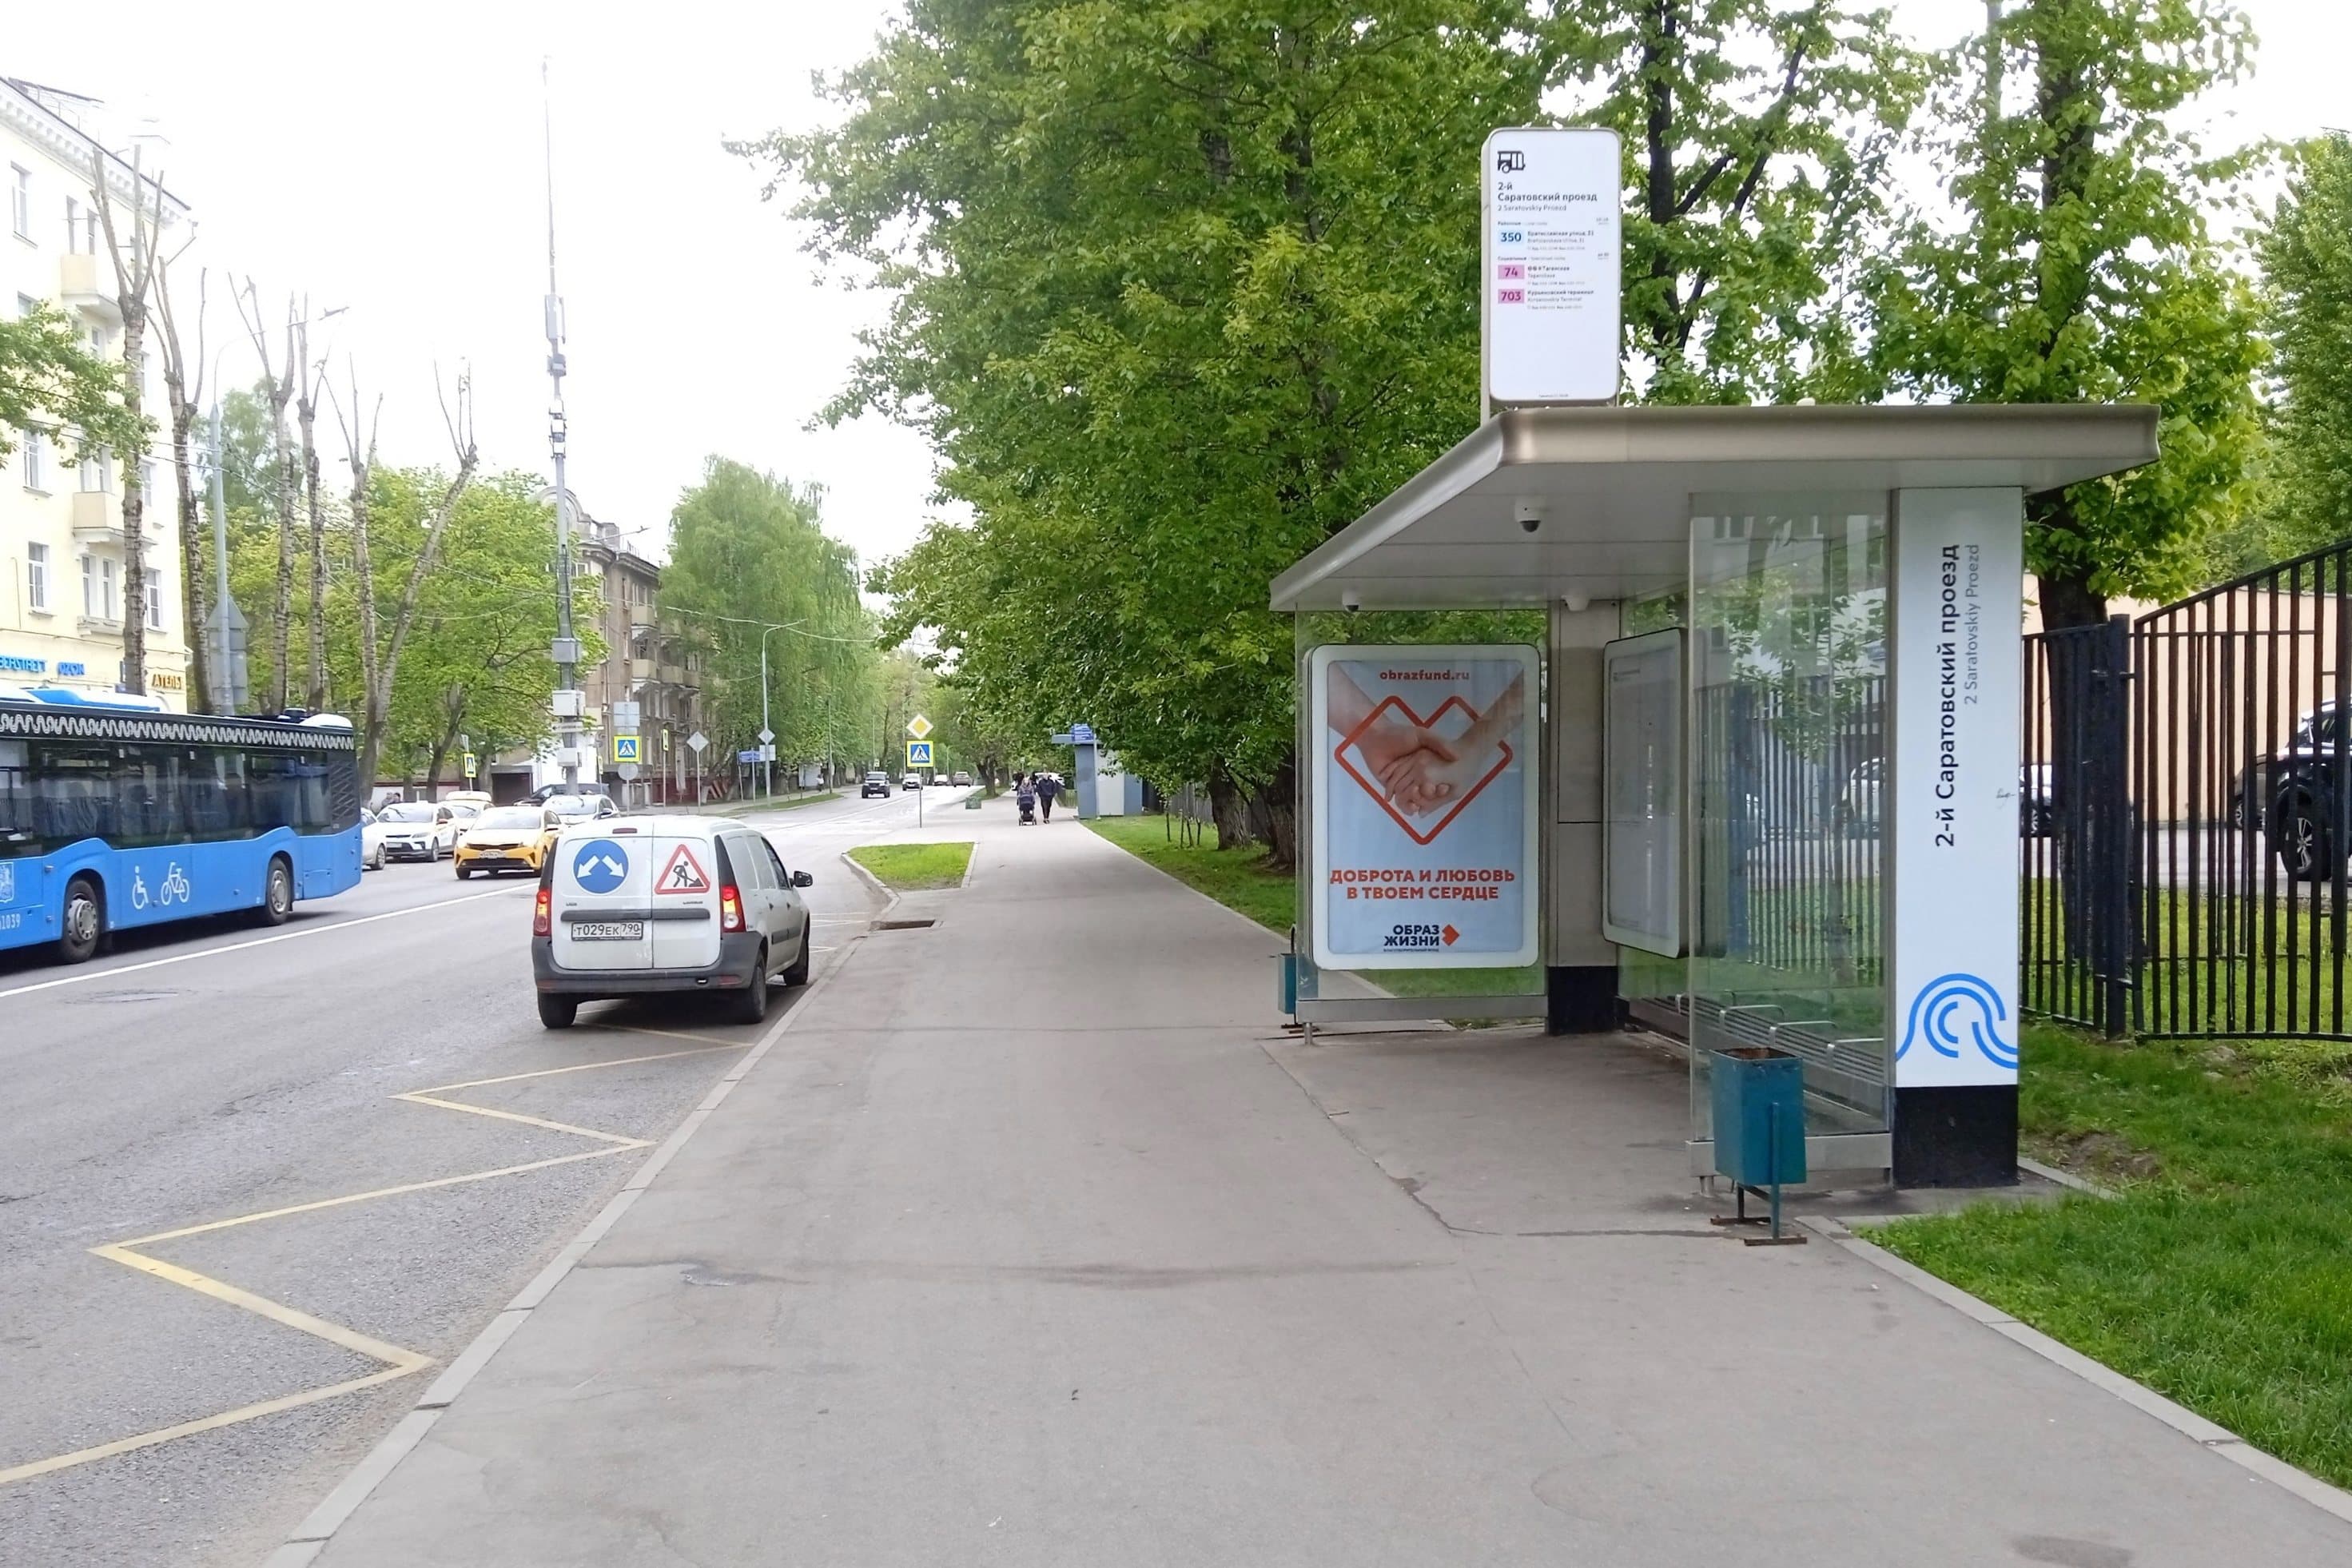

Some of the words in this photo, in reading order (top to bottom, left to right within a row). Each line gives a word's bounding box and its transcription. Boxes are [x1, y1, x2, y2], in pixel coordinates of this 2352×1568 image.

[1498, 181, 1513, 191] 2-й
[1498, 193, 1560, 202] Саратовский
[1562, 193, 1598, 202] проезд
[1501, 232, 1522, 242] 350
[1504, 268, 1518, 277] 74
[1501, 291, 1522, 301] 703
[1964, 544, 1980, 598] Proezd
[1940, 544, 1961, 634] проезд
[1964, 603, 1981, 690] Saratovskiy
[1379, 669, 1470, 680] obrazfund.ru
[1964, 694, 1978, 705] 2
[1936, 642, 1959, 800] Саратовский
[1935, 809, 1955, 847] 2-й
[1330, 870, 1415, 884] ДОБРОТА
[1419, 870, 1431, 882] И
[1435, 870, 1515, 882] ЛЮБОВЬ
[1347, 887, 1358, 899] В
[1362, 887, 1423, 899] ТВОЕМ
[1428, 887, 1498, 901] СЕРДЦЕ
[0, 913, 21, 930] 1039
[1393, 925, 1439, 935] ОБРАЗ
[1383, 936, 1439, 946] ЖИЗНИ
